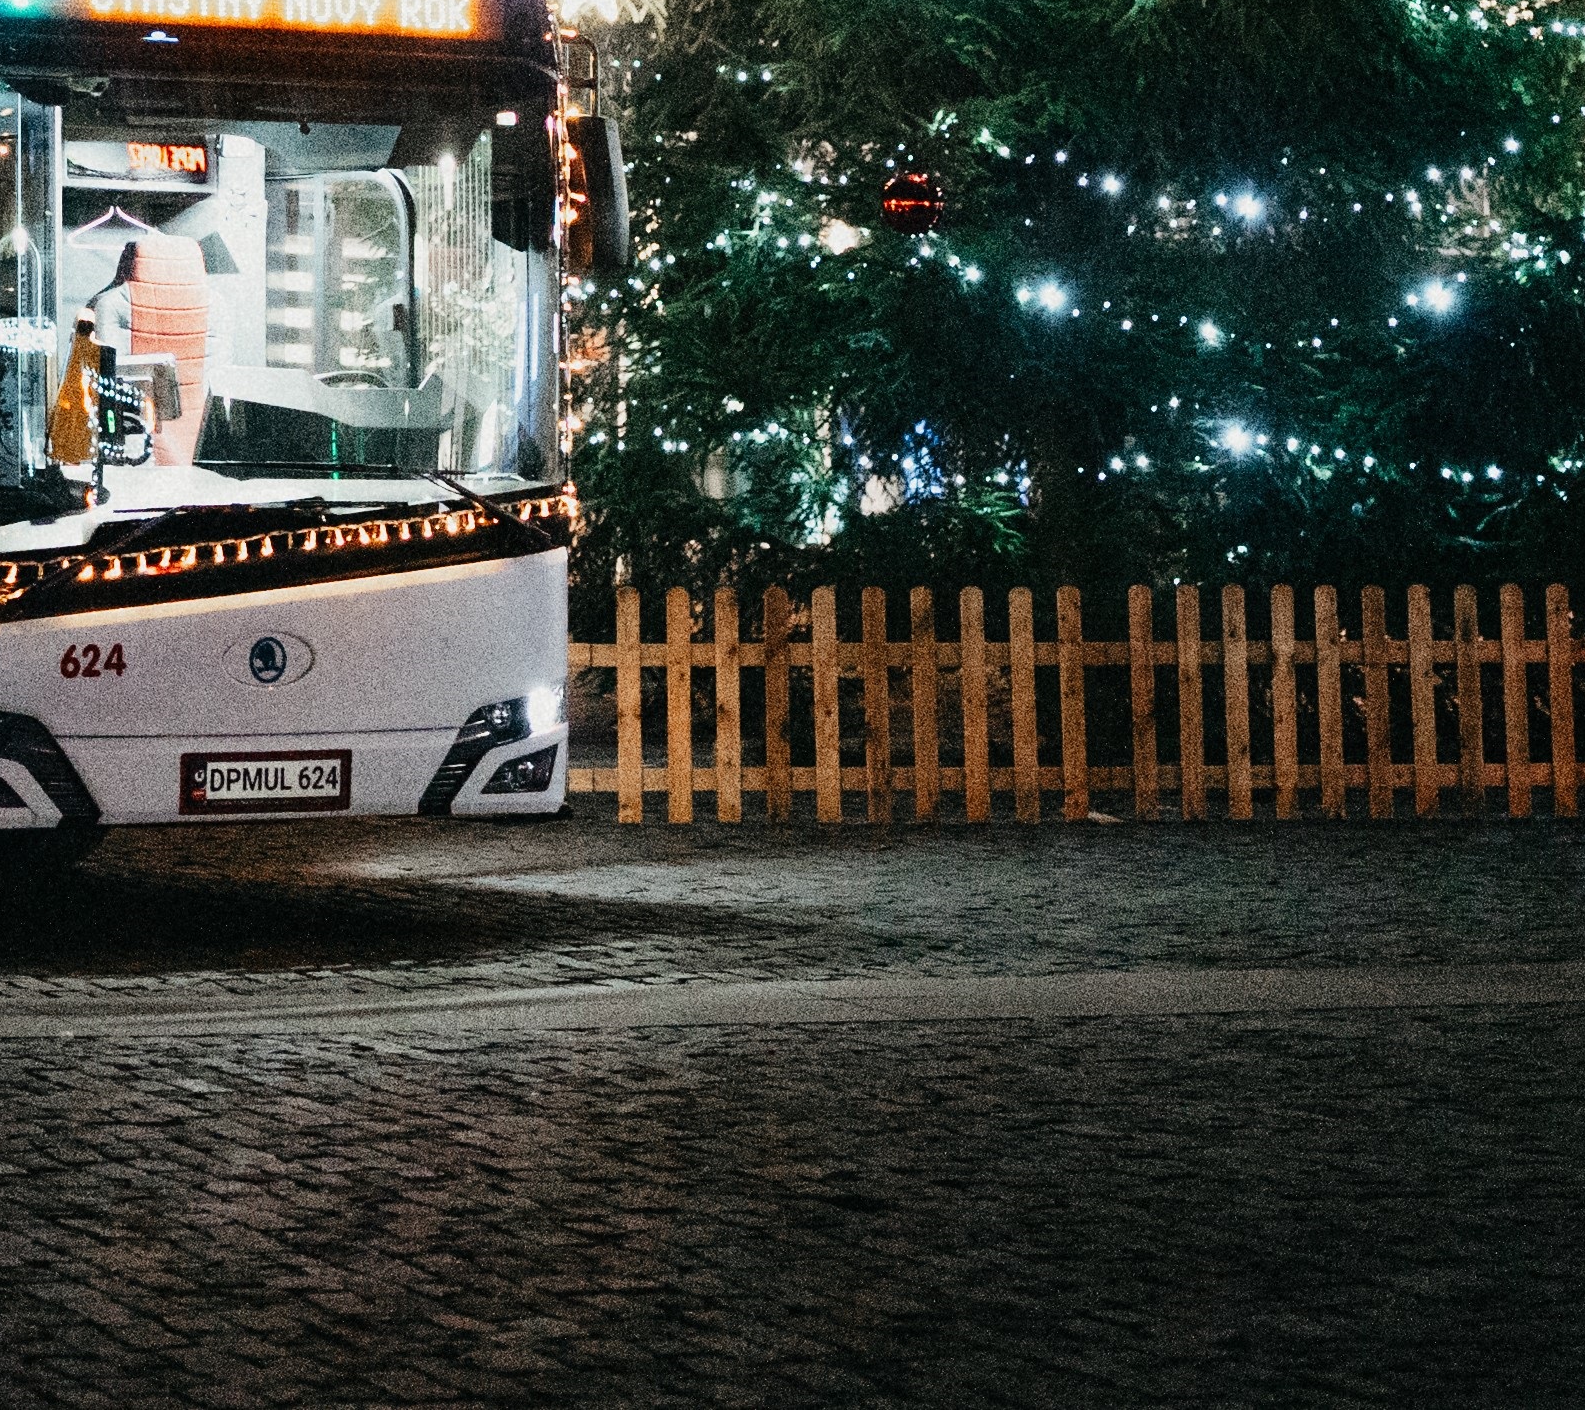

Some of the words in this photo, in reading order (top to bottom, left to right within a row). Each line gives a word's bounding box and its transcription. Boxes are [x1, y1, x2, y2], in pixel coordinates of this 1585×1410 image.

[59, 643, 127, 679] 624
[210, 767, 292, 793] DPMUL
[298, 765, 339, 791] 624
